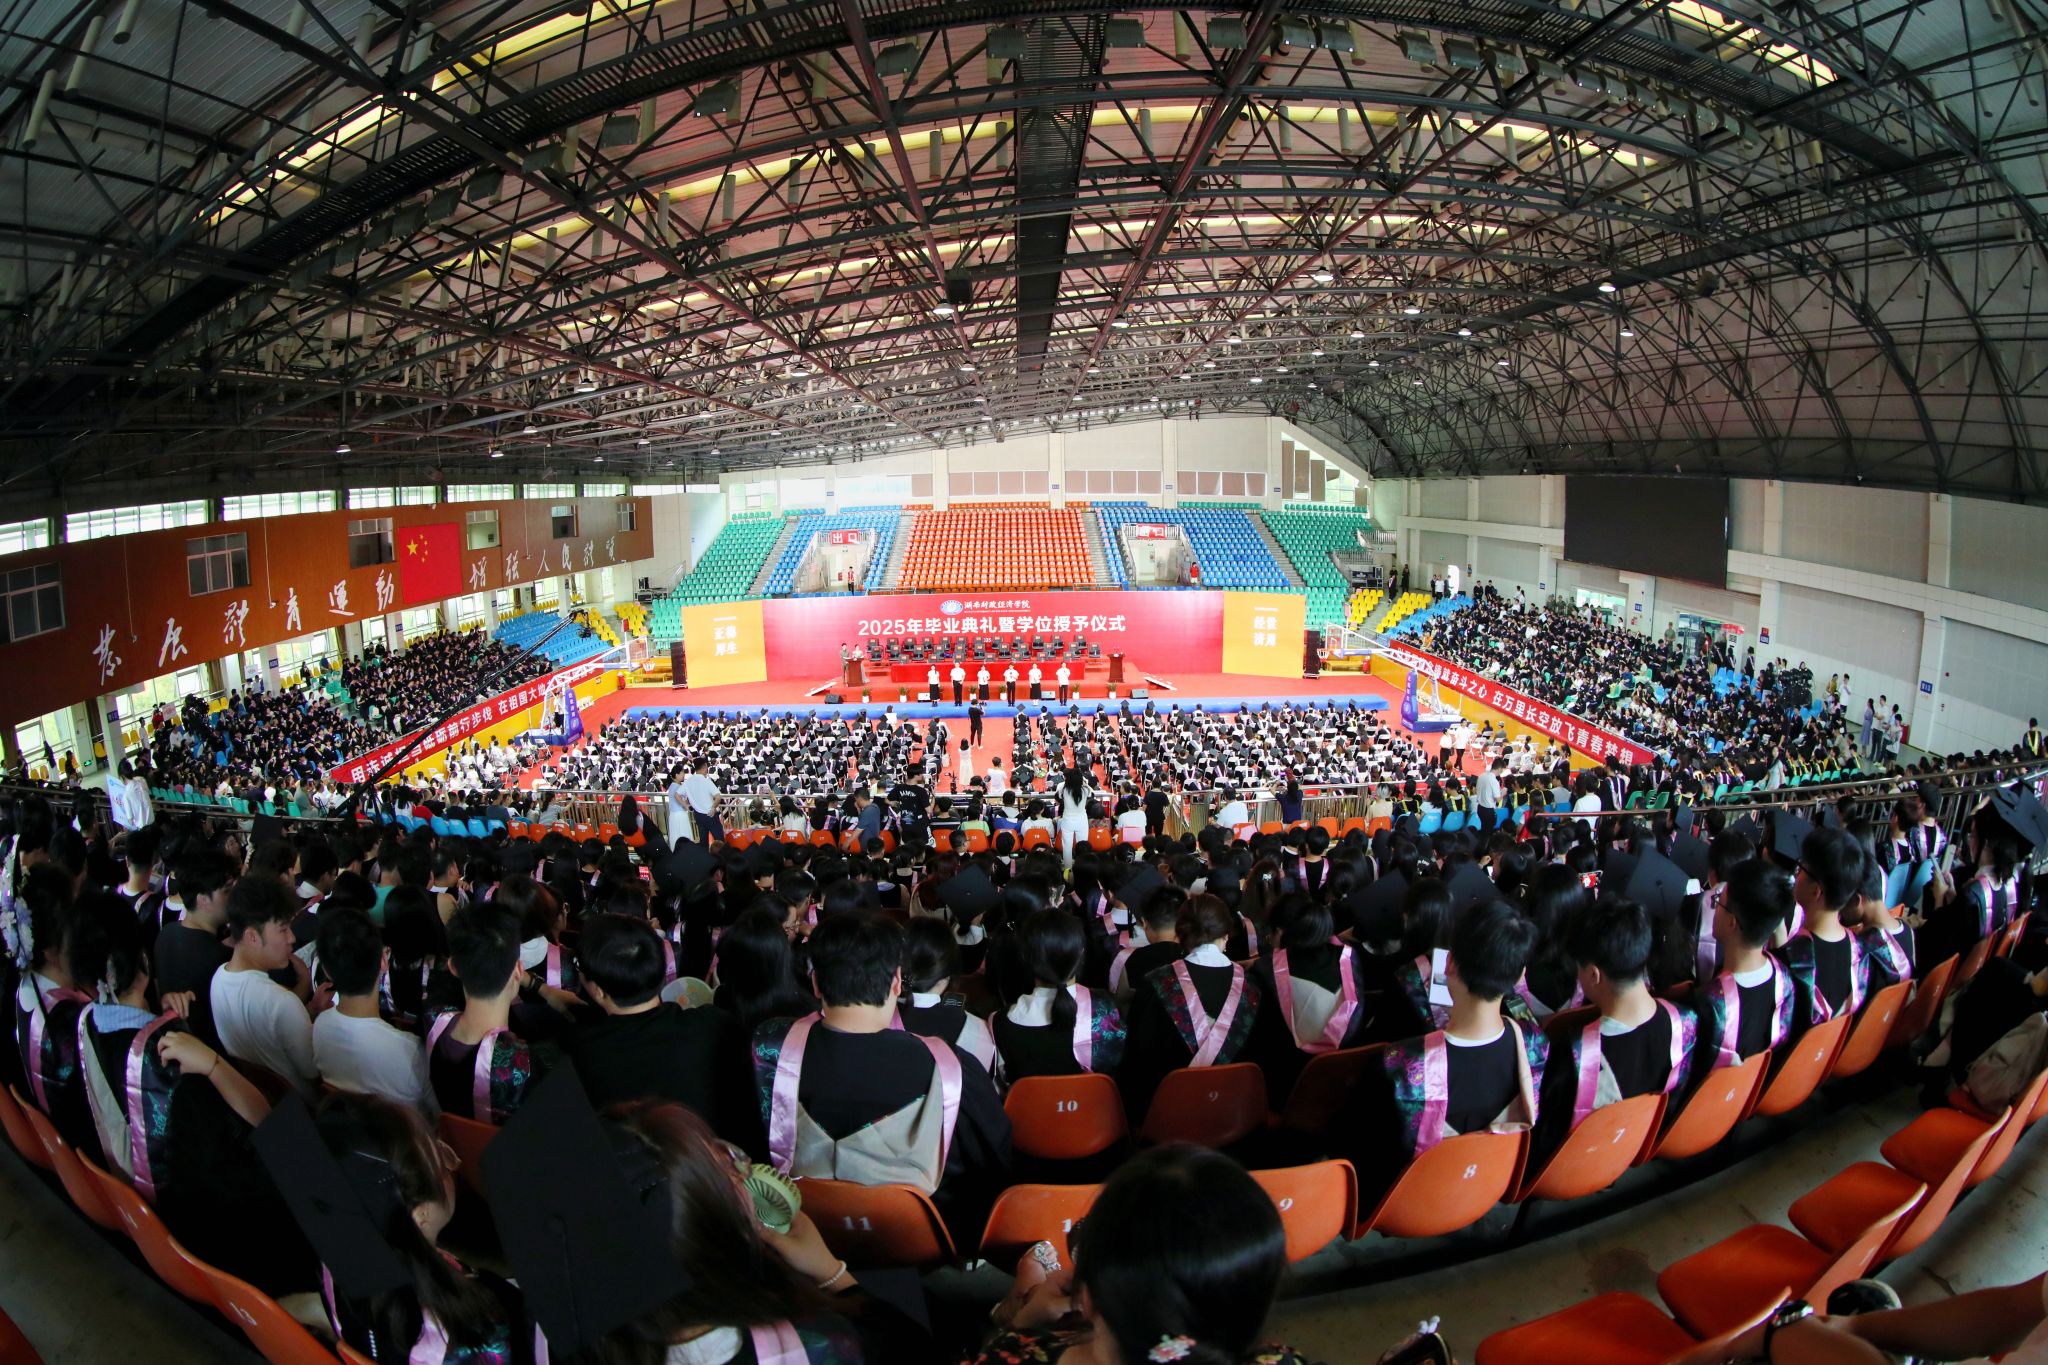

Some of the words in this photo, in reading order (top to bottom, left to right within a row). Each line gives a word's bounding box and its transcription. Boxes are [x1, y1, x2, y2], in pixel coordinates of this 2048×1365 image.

[832, 532, 858, 544] 出口
[858, 615, 1126, 636] 2025年毕业典礼暨学位授予仪式
[1209, 1090, 1219, 1102] 9
[1724, 1087, 1736, 1103] 6
[1056, 1100, 1078, 1113] 10
[1612, 1128, 1626, 1145] 7
[1462, 1164, 1478, 1179] 8
[1279, 1197, 1293, 1211] 9
[843, 1216, 873, 1231] 11
